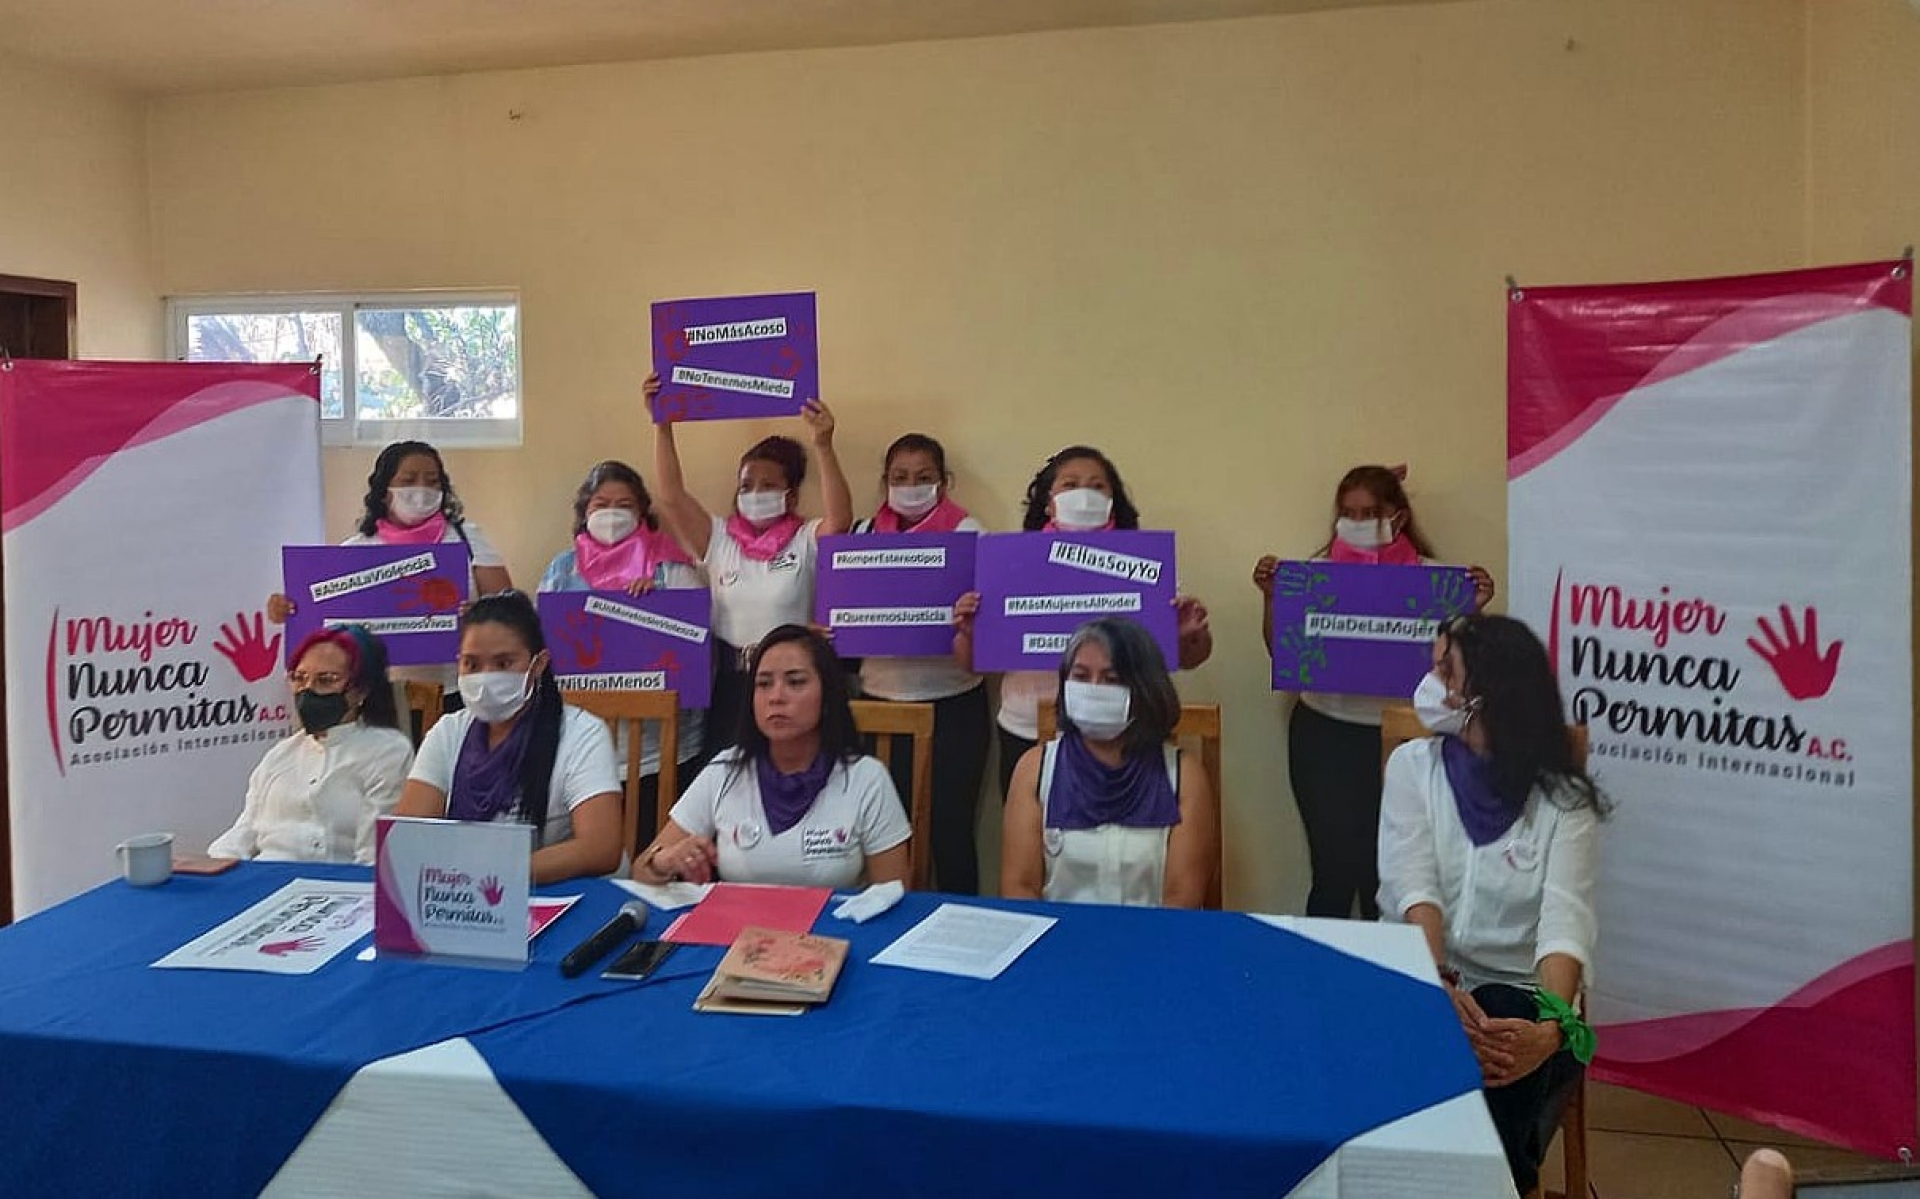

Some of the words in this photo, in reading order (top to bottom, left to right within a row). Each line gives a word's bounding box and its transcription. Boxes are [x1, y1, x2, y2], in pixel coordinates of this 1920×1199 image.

[687, 323, 784, 342] #NoMásAcoso
[678, 370, 790, 395] #NoTenemosMiedo
[314, 557, 431, 597] #AltoALaViolencia
[836, 553, 943, 565] #RomperEstereotipos
[1055, 543, 1157, 580] #EllasSoyYo
[836, 610, 946, 623] #QueremosJusticia
[1008, 596, 1136, 612] #MásMujeresAlPoder
[1570, 582, 1726, 648] Mujer
[66, 611, 198, 662] Mujer
[68, 660, 209, 700] Nunca
[1572, 635, 1741, 691] Nunca
[69, 692, 258, 744] Permitas
[258, 705, 291, 722] A.C.
[1572, 687, 1806, 753] Permitas
[1806, 737, 1853, 762] A.C.
[70, 743, 169, 766] Asociación
[1698, 755, 1855, 787] Internacional
